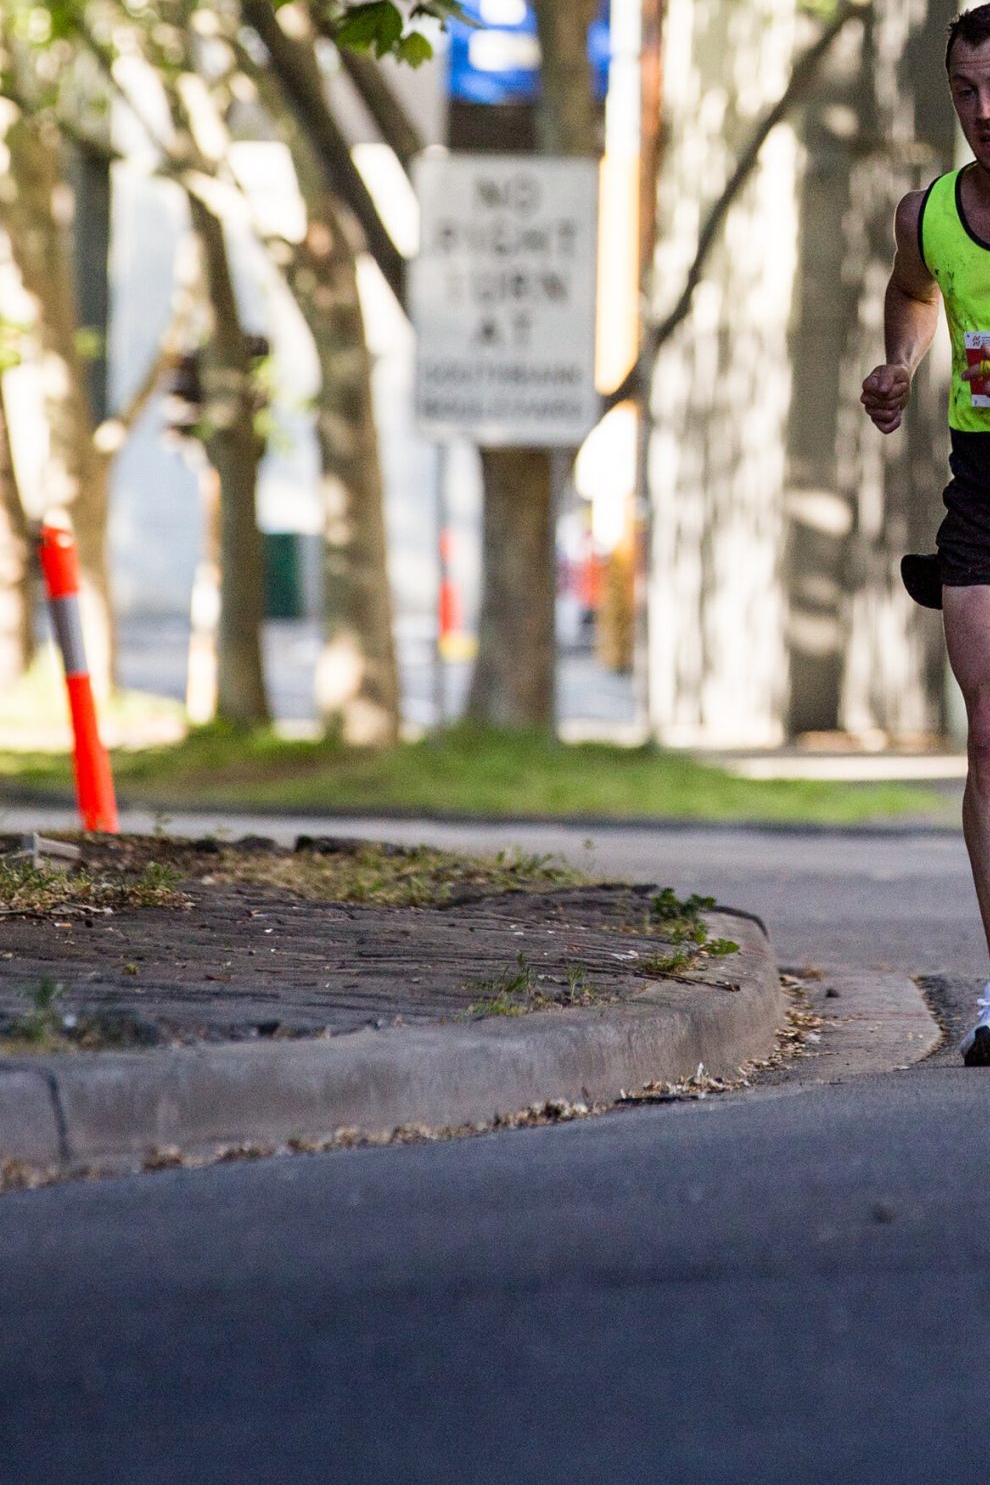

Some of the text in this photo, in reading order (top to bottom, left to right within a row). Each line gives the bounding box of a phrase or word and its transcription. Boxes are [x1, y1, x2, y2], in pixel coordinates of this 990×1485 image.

[476, 175, 542, 215] NO
[445, 267, 567, 306] TURN
[473, 312, 534, 351] AT
